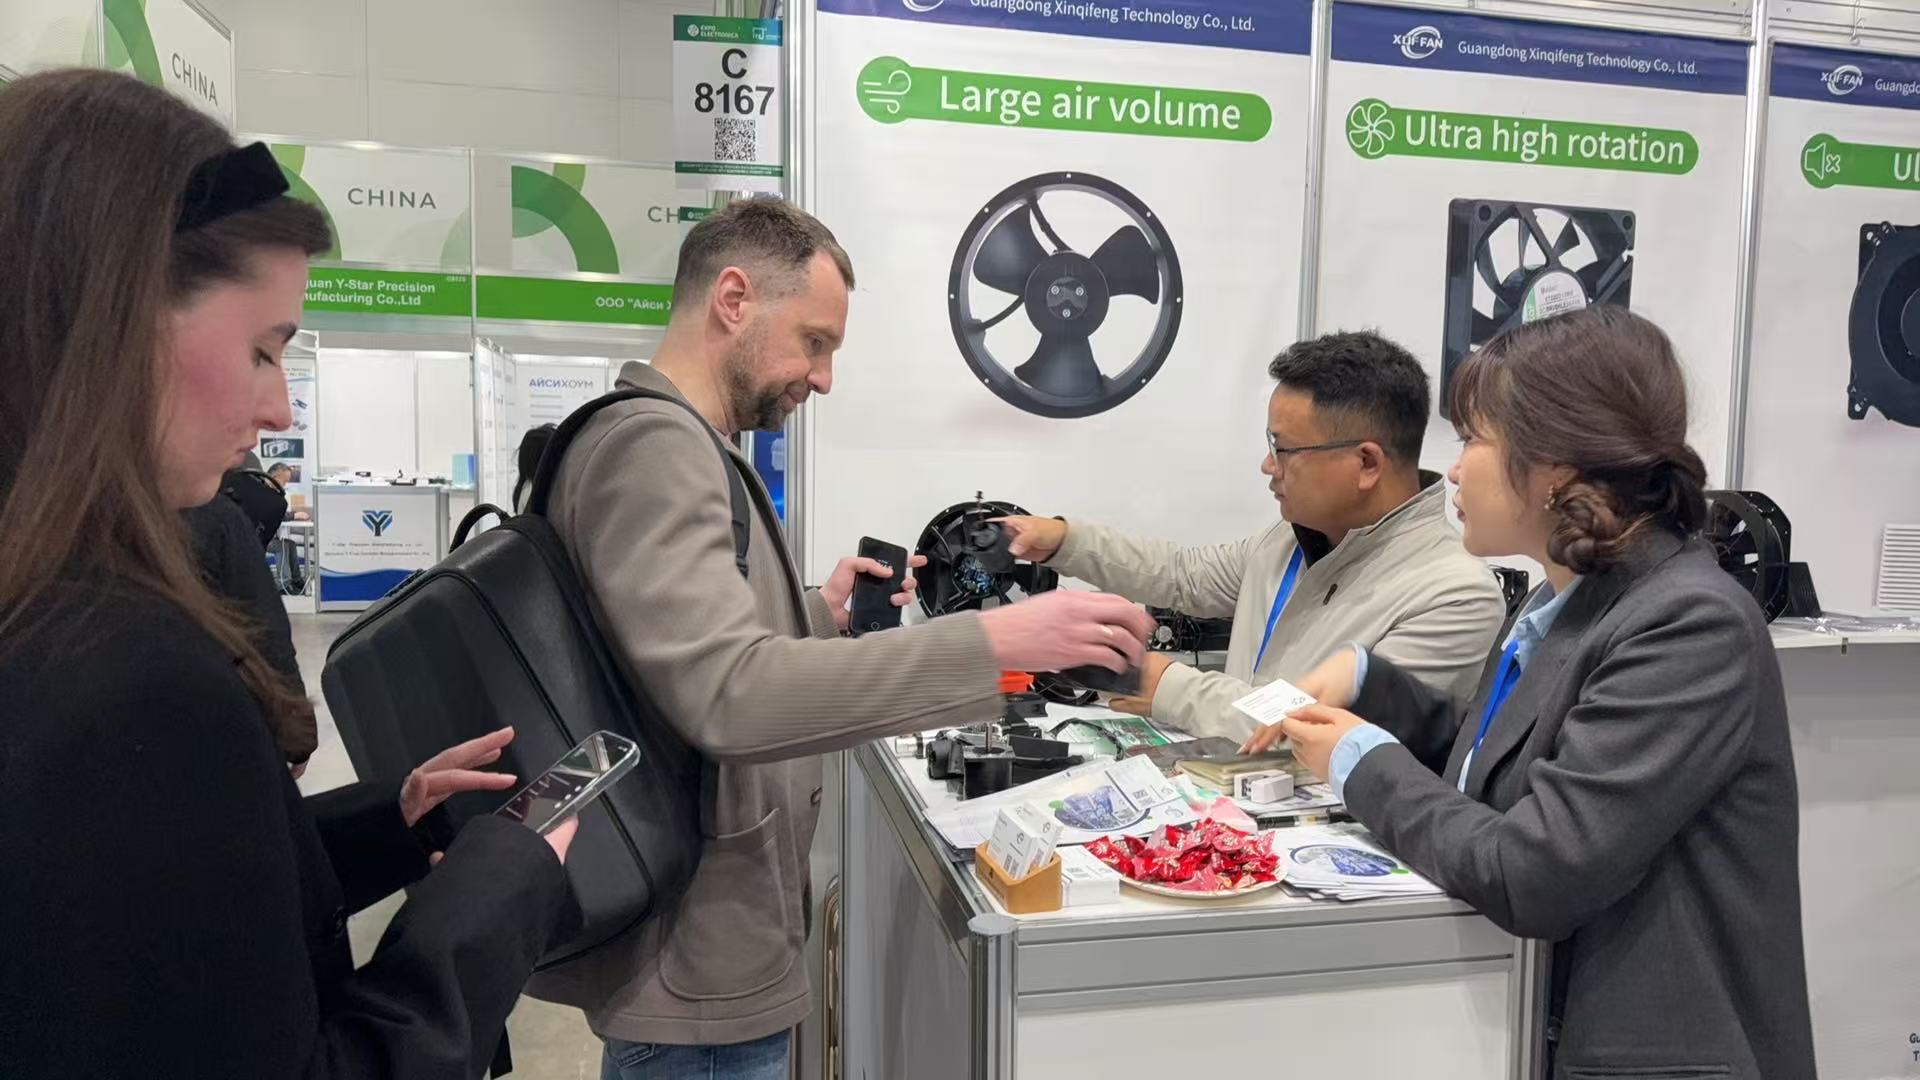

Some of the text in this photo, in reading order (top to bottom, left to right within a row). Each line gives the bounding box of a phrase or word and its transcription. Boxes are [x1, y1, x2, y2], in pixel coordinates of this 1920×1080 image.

[970, 0, 1256, 31] Guangdong Xinqifeng Technology Co., Ltd.
[722, 48, 747, 79] C
[1458, 41, 1698, 75] Guangdong Xinqifeng Technology Co., Ltd.
[171, 52, 218, 107] CHINA
[695, 82, 775, 115] 8167
[941, 76, 1241, 130] Large air volume
[1406, 114, 1685, 165] Ultra high rotation
[347, 187, 437, 209] CHINA
[336, 278, 374, 291] Y-Star
[377, 280, 436, 293] Precision
[595, 297, 625, 308] ООО
[529, 376, 594, 389] АЙСИХОУМ
